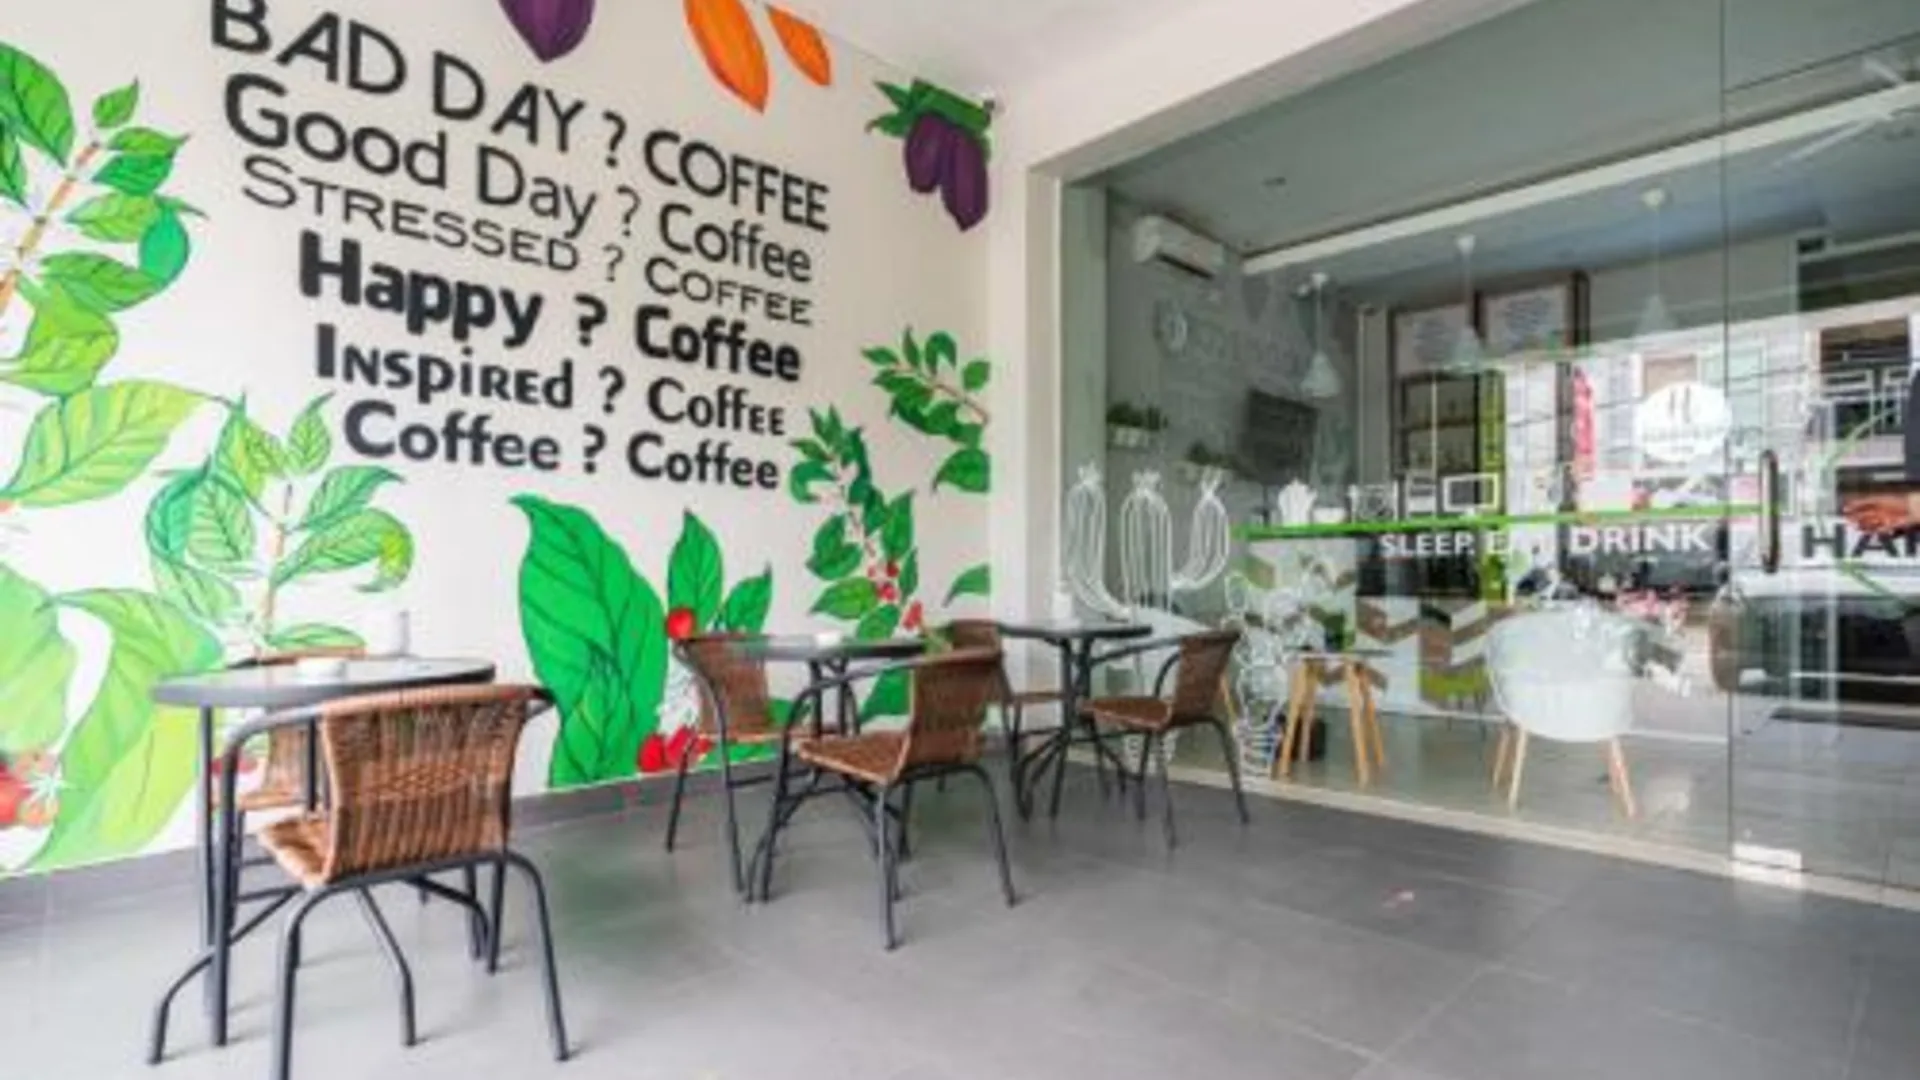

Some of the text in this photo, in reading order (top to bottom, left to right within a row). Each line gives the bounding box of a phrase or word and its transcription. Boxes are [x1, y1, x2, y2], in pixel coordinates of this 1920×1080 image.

[209, 0, 831, 234] BAD DAY ? COFFEE
[223, 71, 814, 285] Good Day ? Coffee
[242, 154, 814, 328] STRESSED ? COFFEE
[298, 228, 804, 385] Happy ? Coffee
[343, 398, 781, 491] Coffee ? Coffee
[598, 365, 627, 415] ?
[1570, 524, 1709, 554] DRINK
